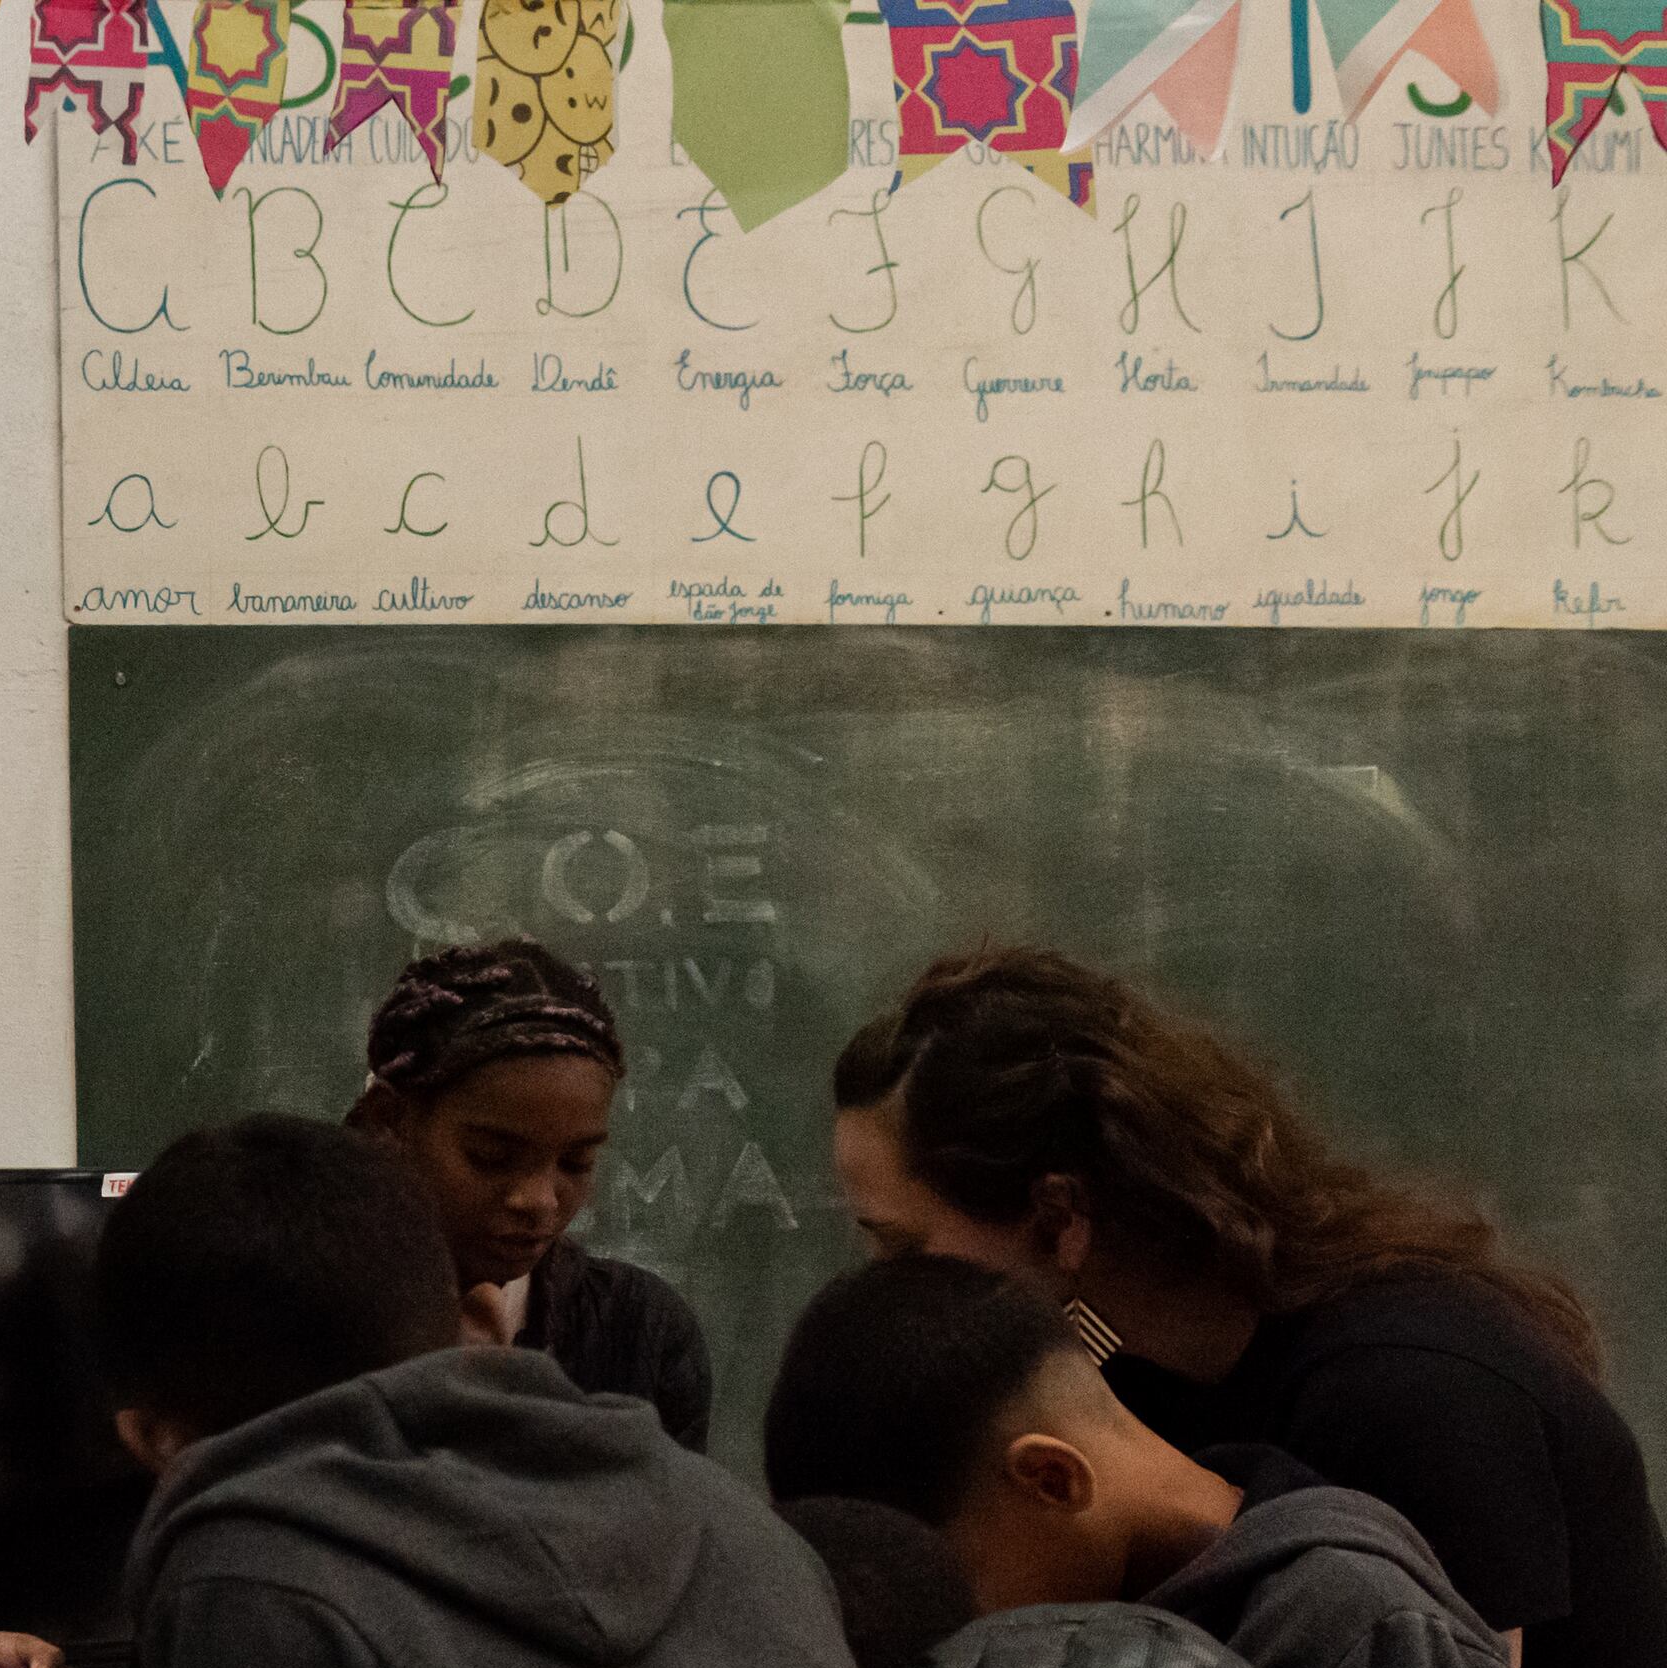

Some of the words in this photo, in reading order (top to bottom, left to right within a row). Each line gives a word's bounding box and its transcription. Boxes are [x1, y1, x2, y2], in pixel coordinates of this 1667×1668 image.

[1243, 120, 1360, 175] INTUIÇÃO
[233, 188, 327, 333] B
[387, 182, 475, 327] C
[536, 191, 623, 318] D
[1112, 192, 1201, 334] H
[1549, 186, 1622, 331] K
[219, 350, 352, 389] Berimbau
[367, 350, 499, 390] Comunidade
[531, 352, 618, 391] Dendê
[675, 349, 784, 411] Energia
[827, 349, 913, 395] Força
[1116, 351, 1198, 392] Horta
[88, 474, 178, 532] a
[245, 445, 325, 540] b
[383, 472, 448, 535] c
[529, 434, 620, 546] d
[690, 470, 757, 542] e
[981, 455, 1058, 560] g
[1121, 438, 1183, 548] h
[1266, 479, 1327, 539] i
[1425, 427, 1480, 561] j
[81, 585, 202, 615] amor
[227, 583, 357, 614] bananeira
[372, 577, 474, 611] cultivo
[522, 578, 634, 611] descanso
[669, 576, 746, 615] espada
[761, 582, 784, 598] de
[825, 581, 913, 625] formiga
[1118, 578, 1230, 622] humano
[1252, 580, 1365, 625] igualdade
